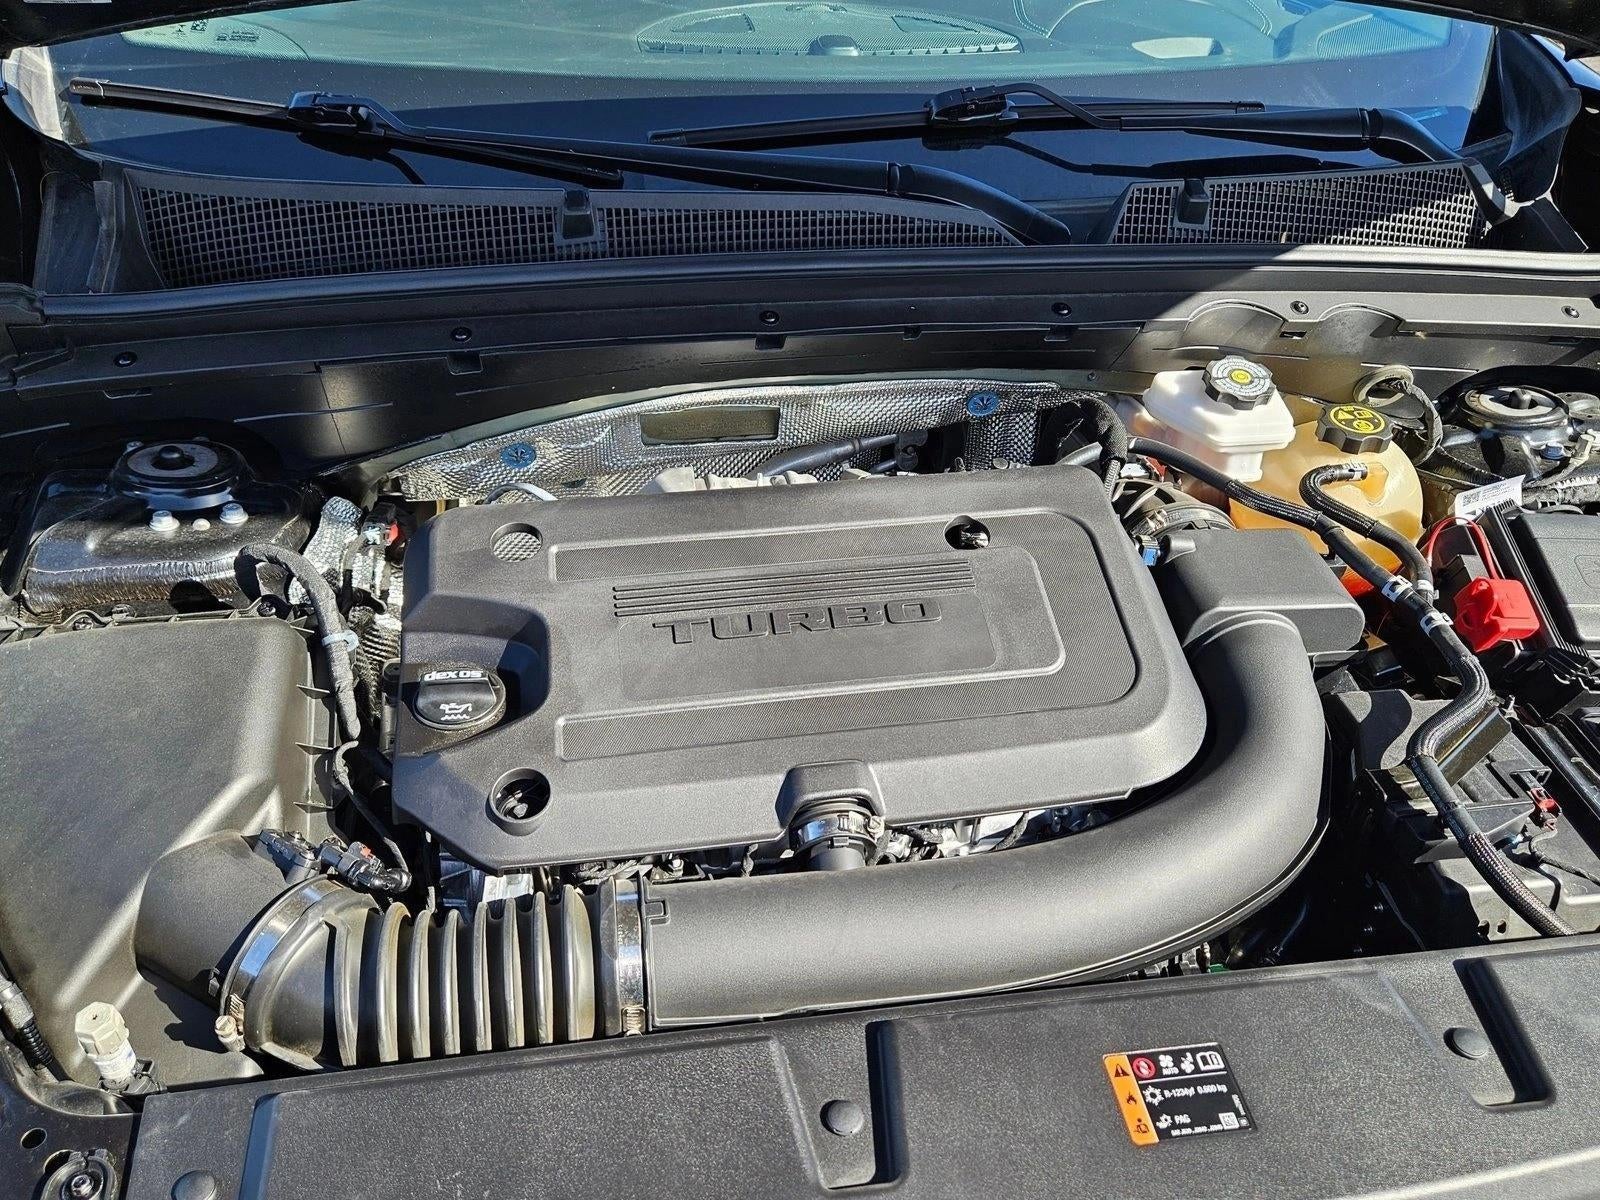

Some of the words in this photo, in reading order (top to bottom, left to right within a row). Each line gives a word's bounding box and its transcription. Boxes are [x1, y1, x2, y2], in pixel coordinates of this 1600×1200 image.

[652, 601, 942, 644] TURBO
[424, 670, 483, 681] dexos
[1163, 1086, 1195, 1098] R-1234yf
[1216, 1083, 1228, 1094] kg
[1174, 1114, 1191, 1125] PAG
